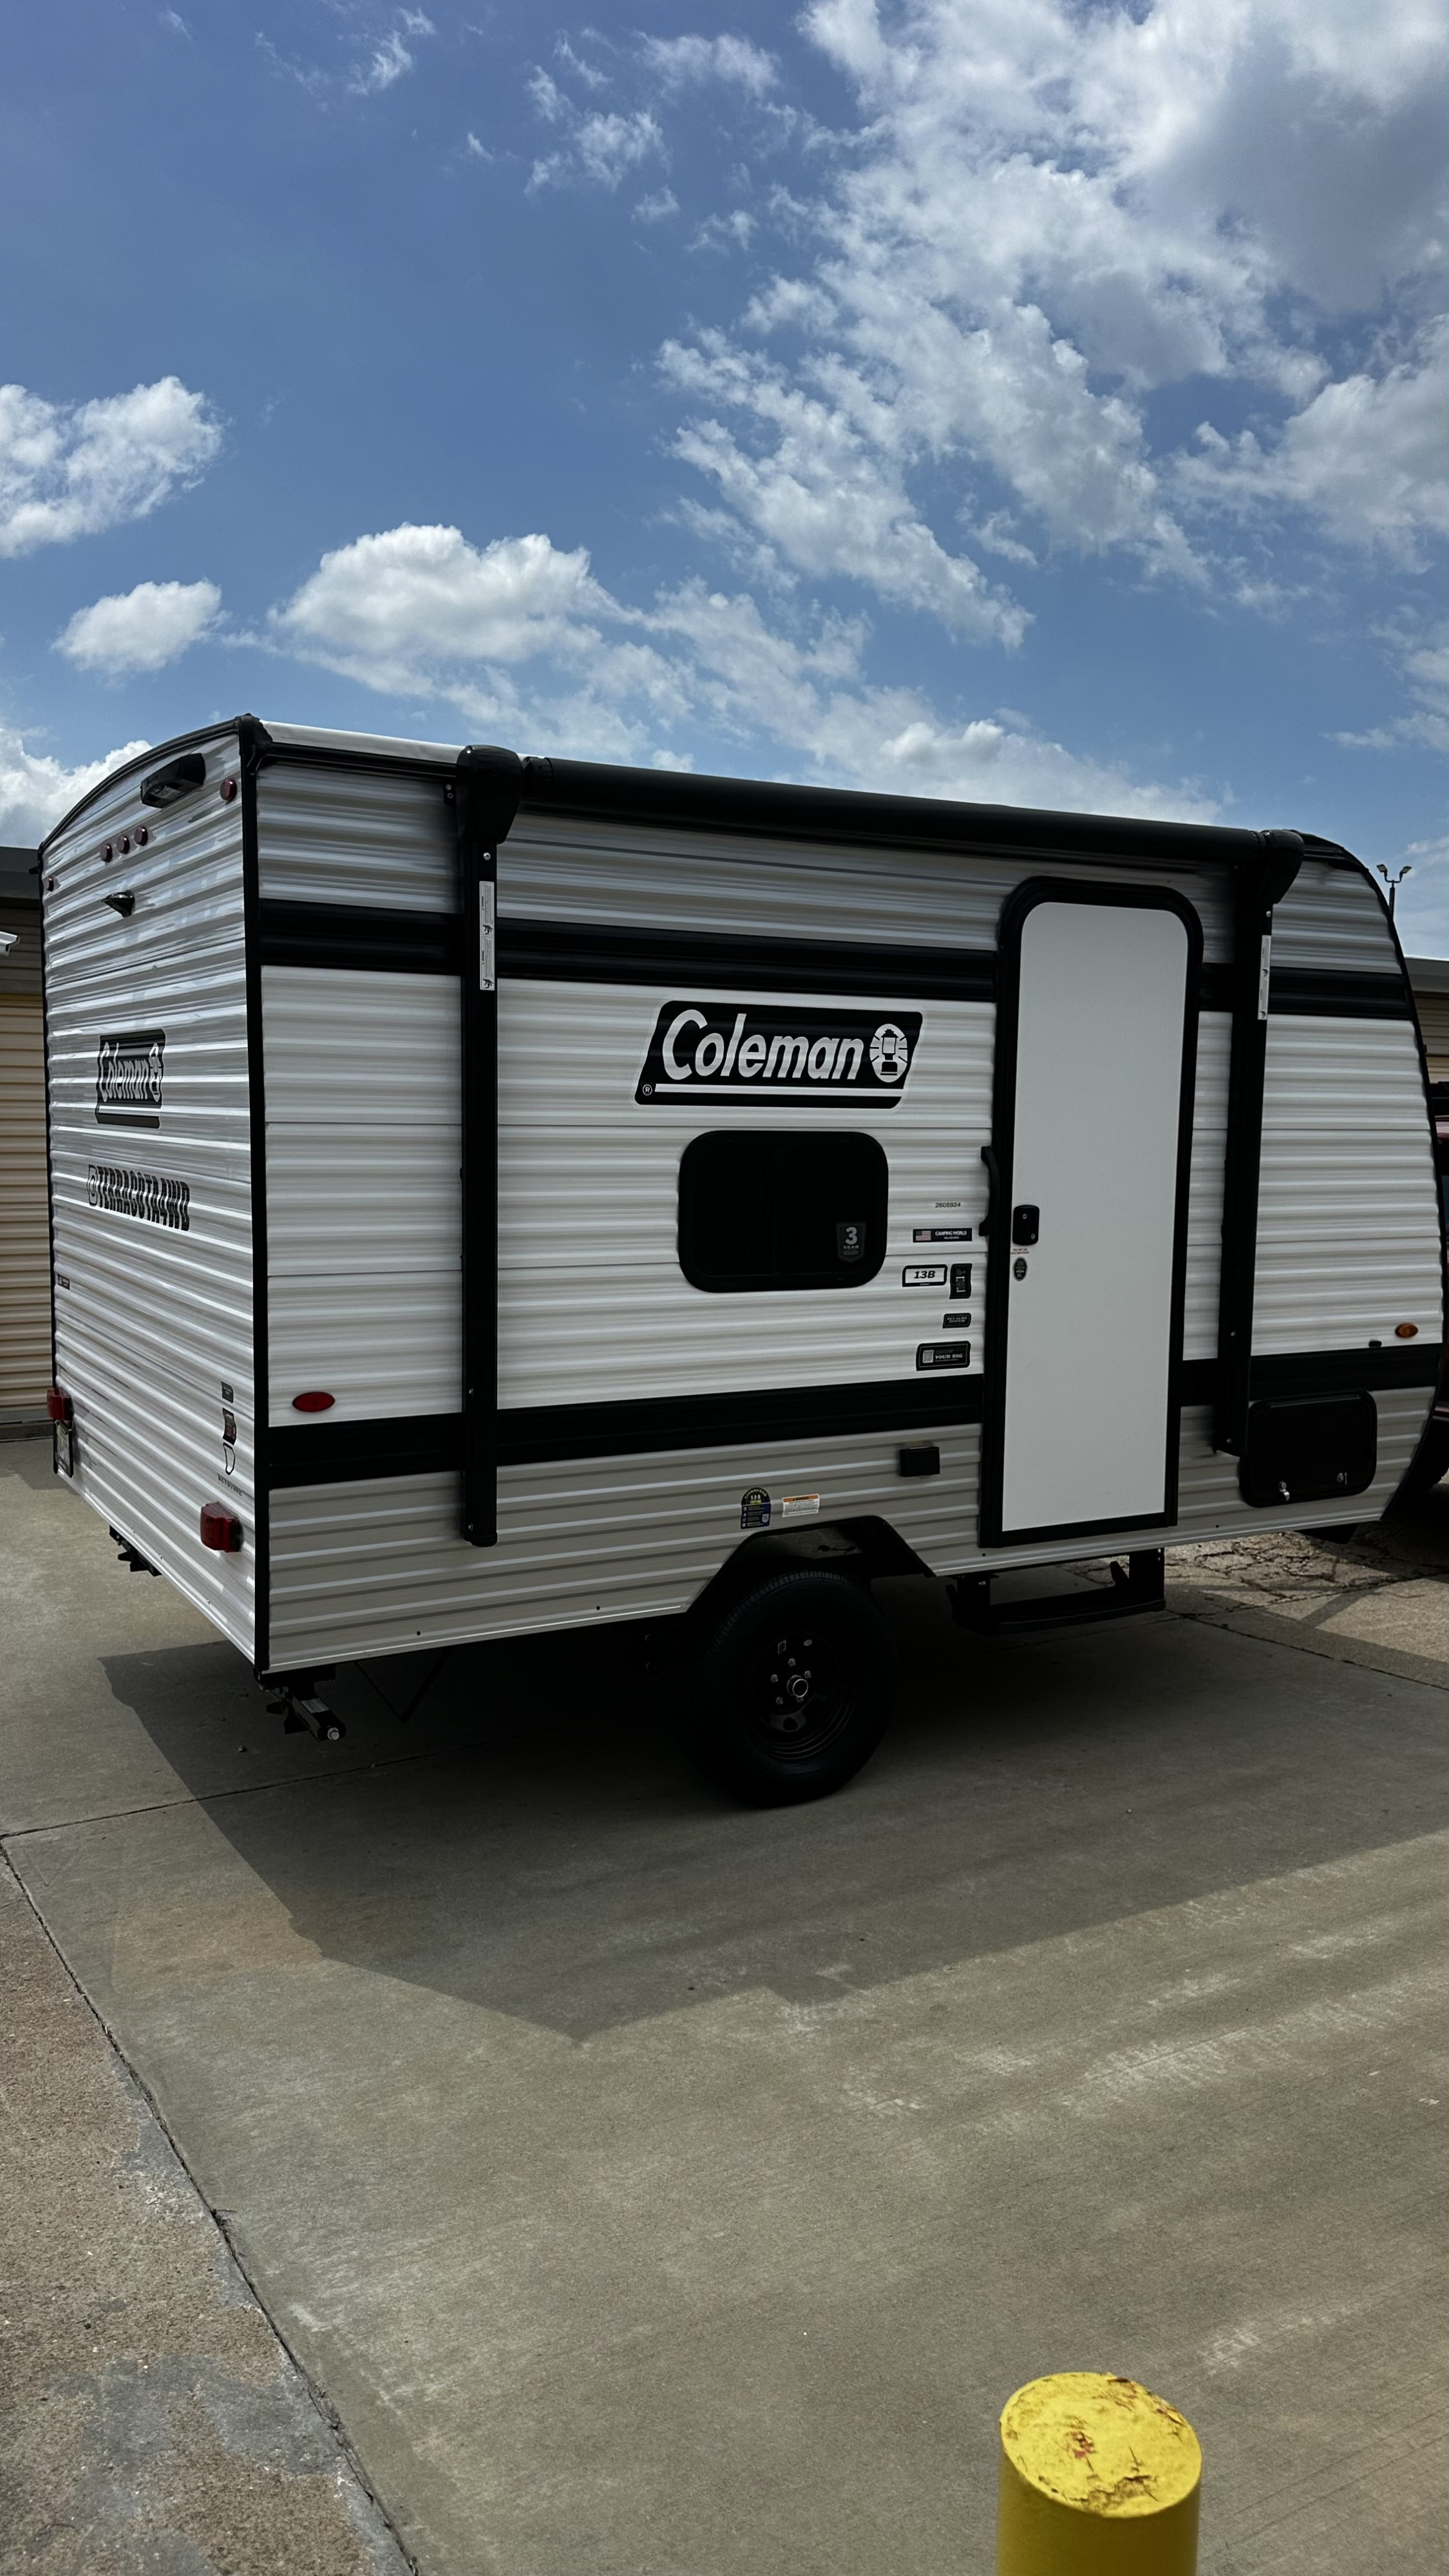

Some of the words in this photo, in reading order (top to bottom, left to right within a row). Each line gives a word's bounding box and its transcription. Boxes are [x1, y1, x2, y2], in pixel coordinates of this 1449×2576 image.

[662, 1009, 864, 1081] Coleman
[99, 1042, 148, 1102] Coleman
[844, 1226, 858, 1245] 3
[914, 1270, 936, 1279] 13B
[216, 1473, 243, 1496] KEYSTONE
